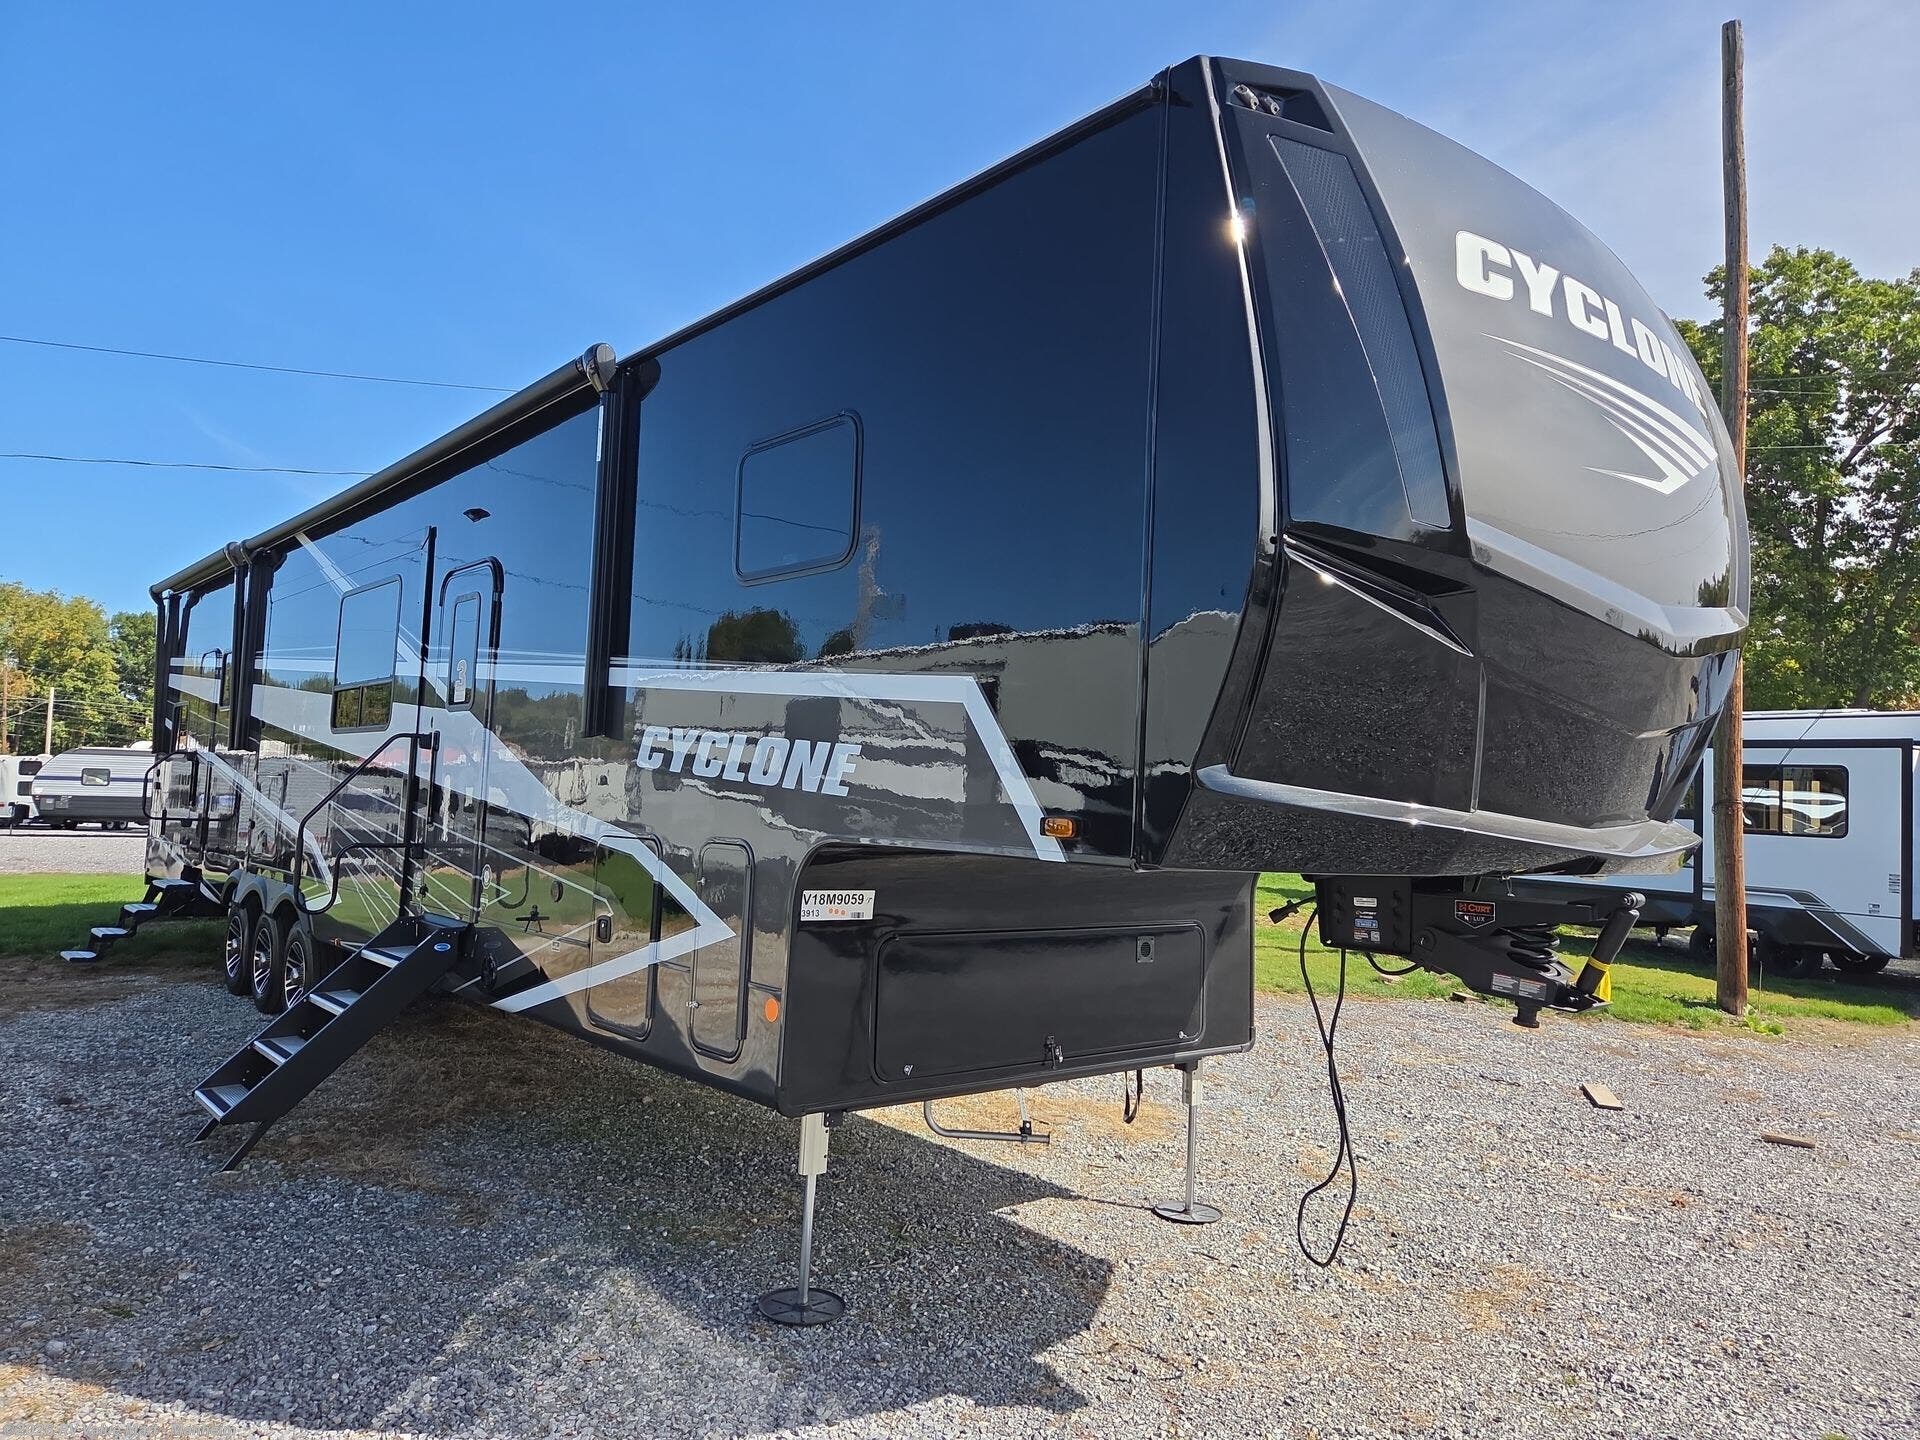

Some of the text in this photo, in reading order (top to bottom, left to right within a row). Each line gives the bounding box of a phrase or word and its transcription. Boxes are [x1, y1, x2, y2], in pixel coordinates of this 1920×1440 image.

[1455, 230, 1708, 418] CYCLONE
[637, 726, 862, 797] CYCLONE
[801, 909, 820, 918] 3913
[803, 893, 865, 906] V18M9059
